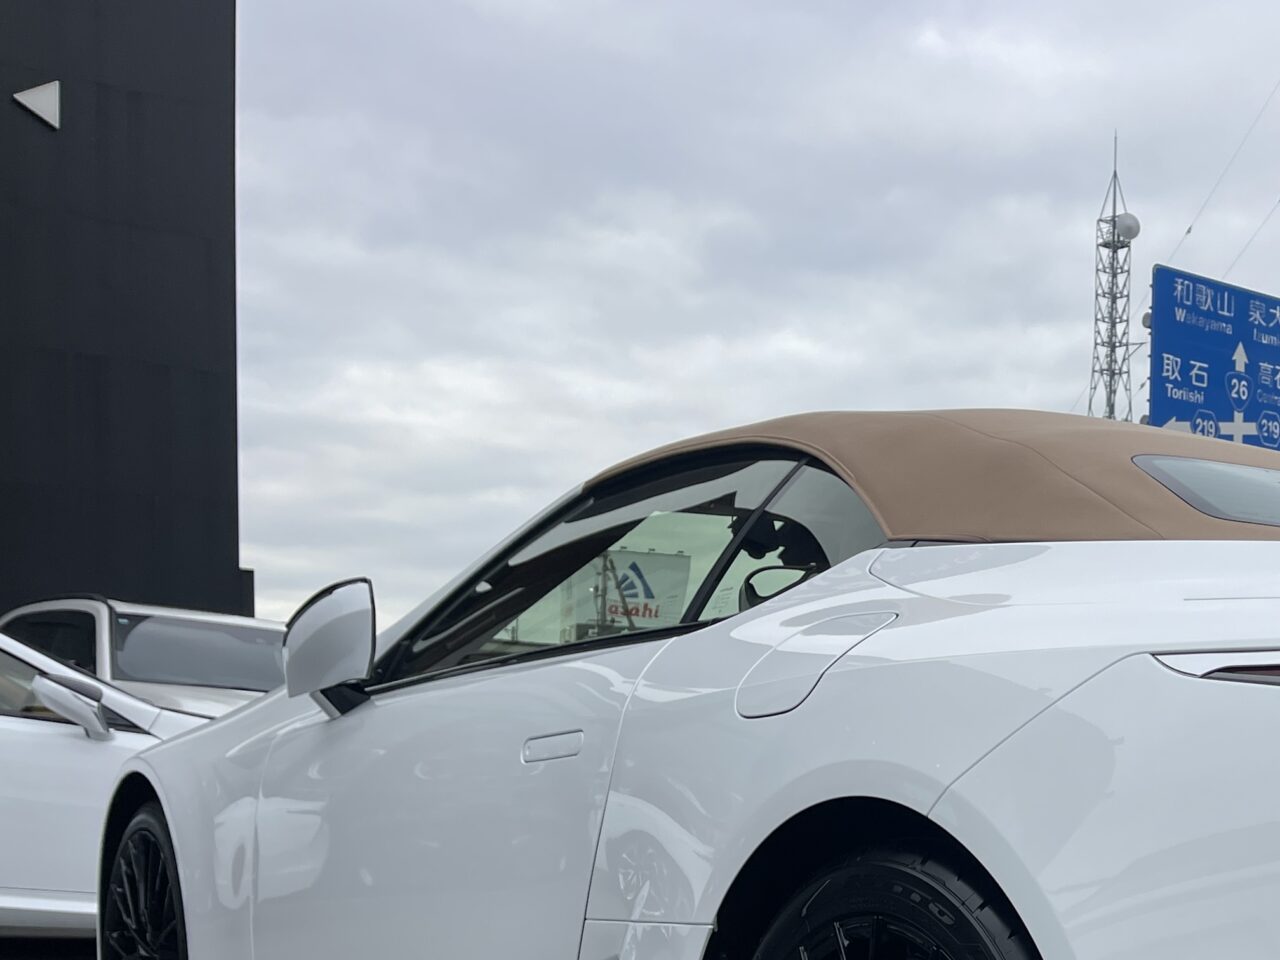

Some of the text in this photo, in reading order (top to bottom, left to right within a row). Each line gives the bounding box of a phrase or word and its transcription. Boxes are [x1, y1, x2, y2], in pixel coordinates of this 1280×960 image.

[1173, 277, 1235, 317] 和歌山
[1174, 306, 1233, 335] Wakayama
[1162, 352, 1208, 388] 取石
[1165, 383, 1205, 404] Toriishi
[1231, 378, 1249, 400] 26
[1195, 418, 1216, 437] 219
[1260, 418, 1280, 439] 219
[607, 602, 661, 618] asahi
